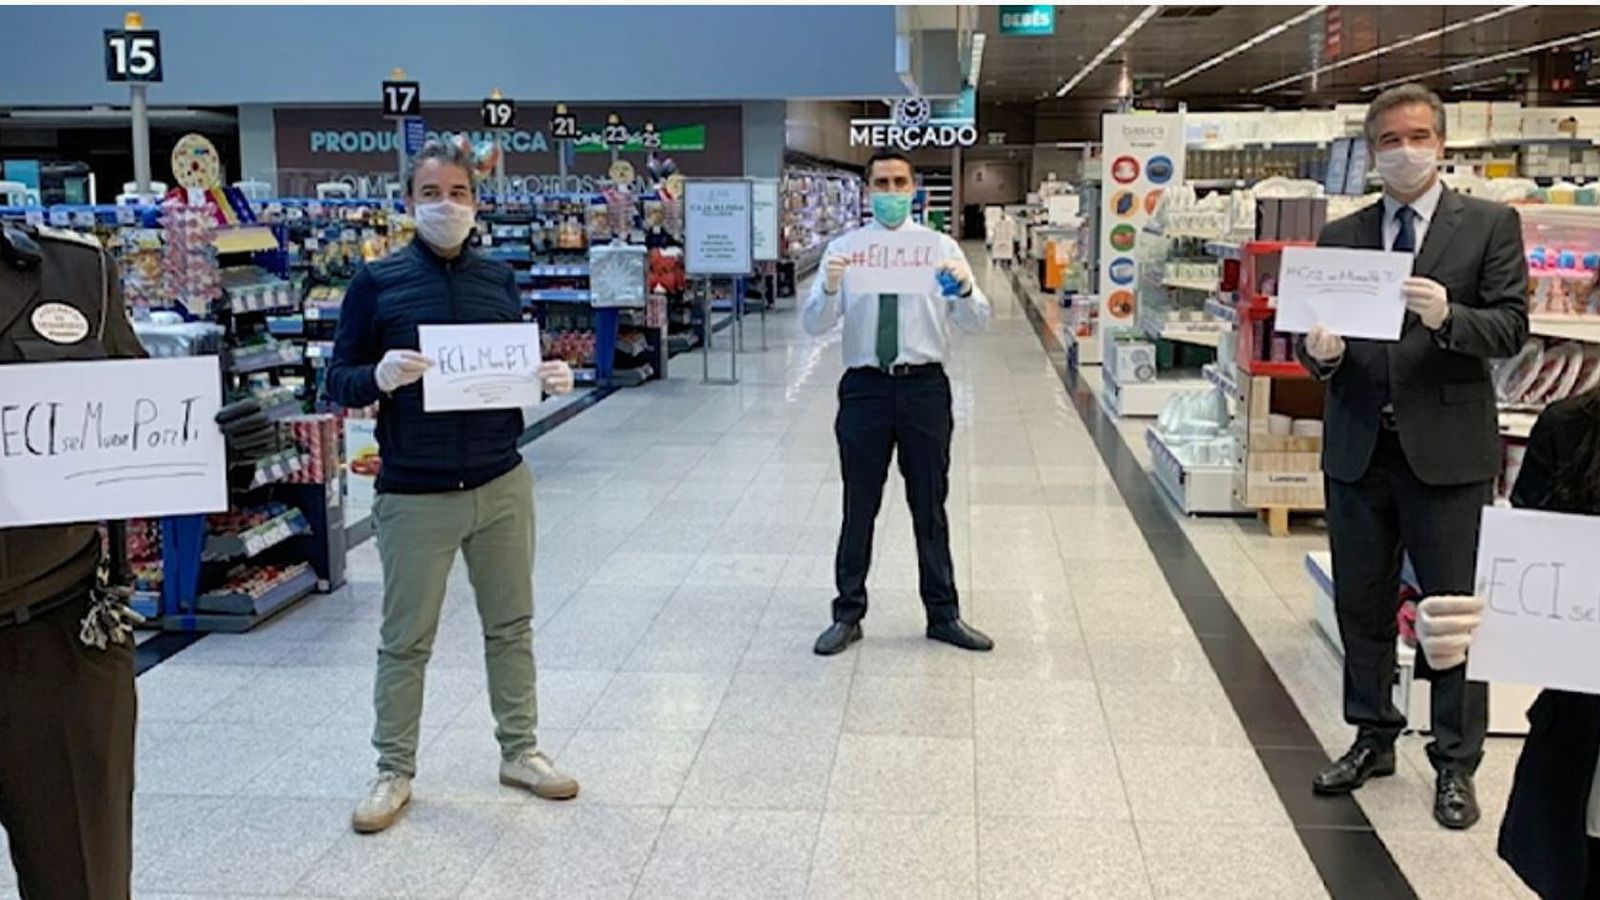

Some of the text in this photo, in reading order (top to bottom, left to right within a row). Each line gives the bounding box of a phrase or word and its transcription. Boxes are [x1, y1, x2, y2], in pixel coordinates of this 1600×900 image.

[109, 38, 156, 75] 15
[385, 86, 416, 113] 17
[487, 104, 512, 125] 19
[554, 117, 575, 136] 21
[606, 126, 628, 142] 23
[643, 132, 661, 148] 25
[850, 125, 977, 150] MERCADO
